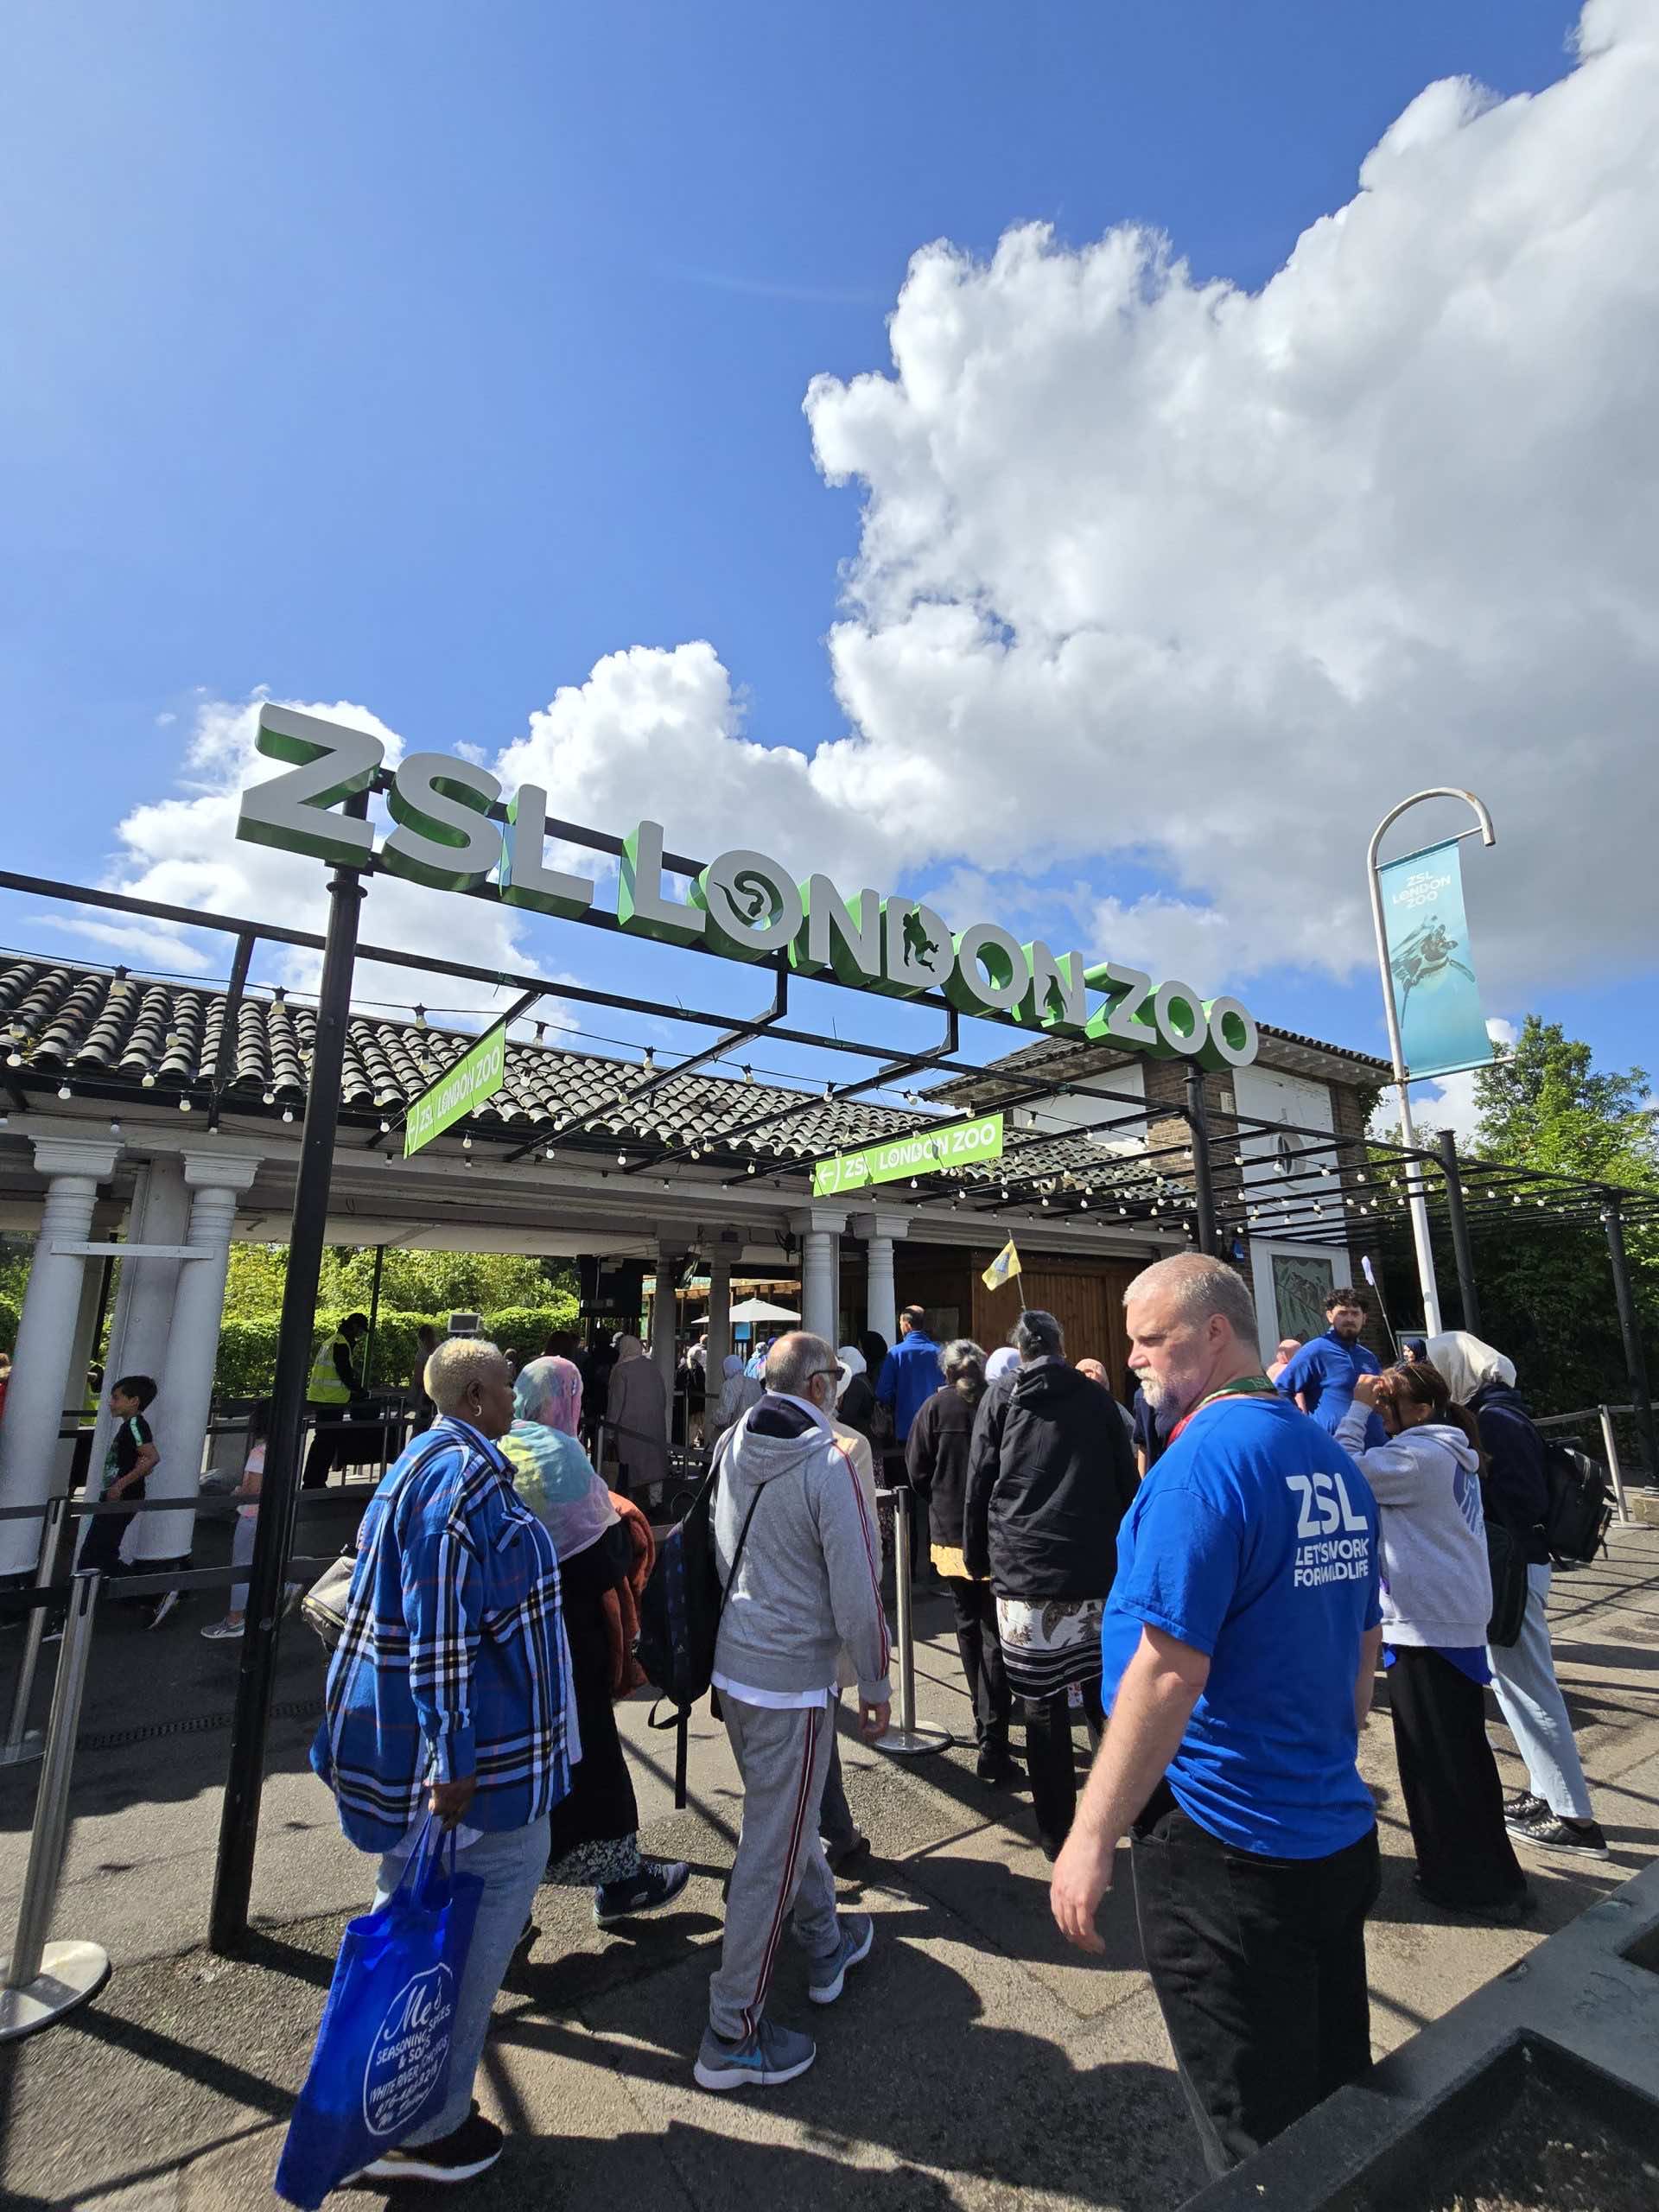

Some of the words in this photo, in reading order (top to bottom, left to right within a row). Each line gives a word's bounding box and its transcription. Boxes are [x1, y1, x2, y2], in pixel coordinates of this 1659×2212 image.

[236, 702, 594, 920] ZSL
[619, 820, 1088, 1030] LONDON
[1085, 962, 1259, 1071] ZOO
[1393, 874, 1452, 905] LONDON
[1406, 871, 1434, 887] ZSL
[1406, 891, 1438, 909] ZOO
[436, 1066, 474, 1119] LONDON
[474, 1046, 501, 1090] ZOO
[879, 1138, 948, 1170] LONDON
[952, 1122, 996, 1153] ZOO
[1286, 1472, 1368, 1539] ZSL
[1294, 1567, 1322, 1587] FOR
